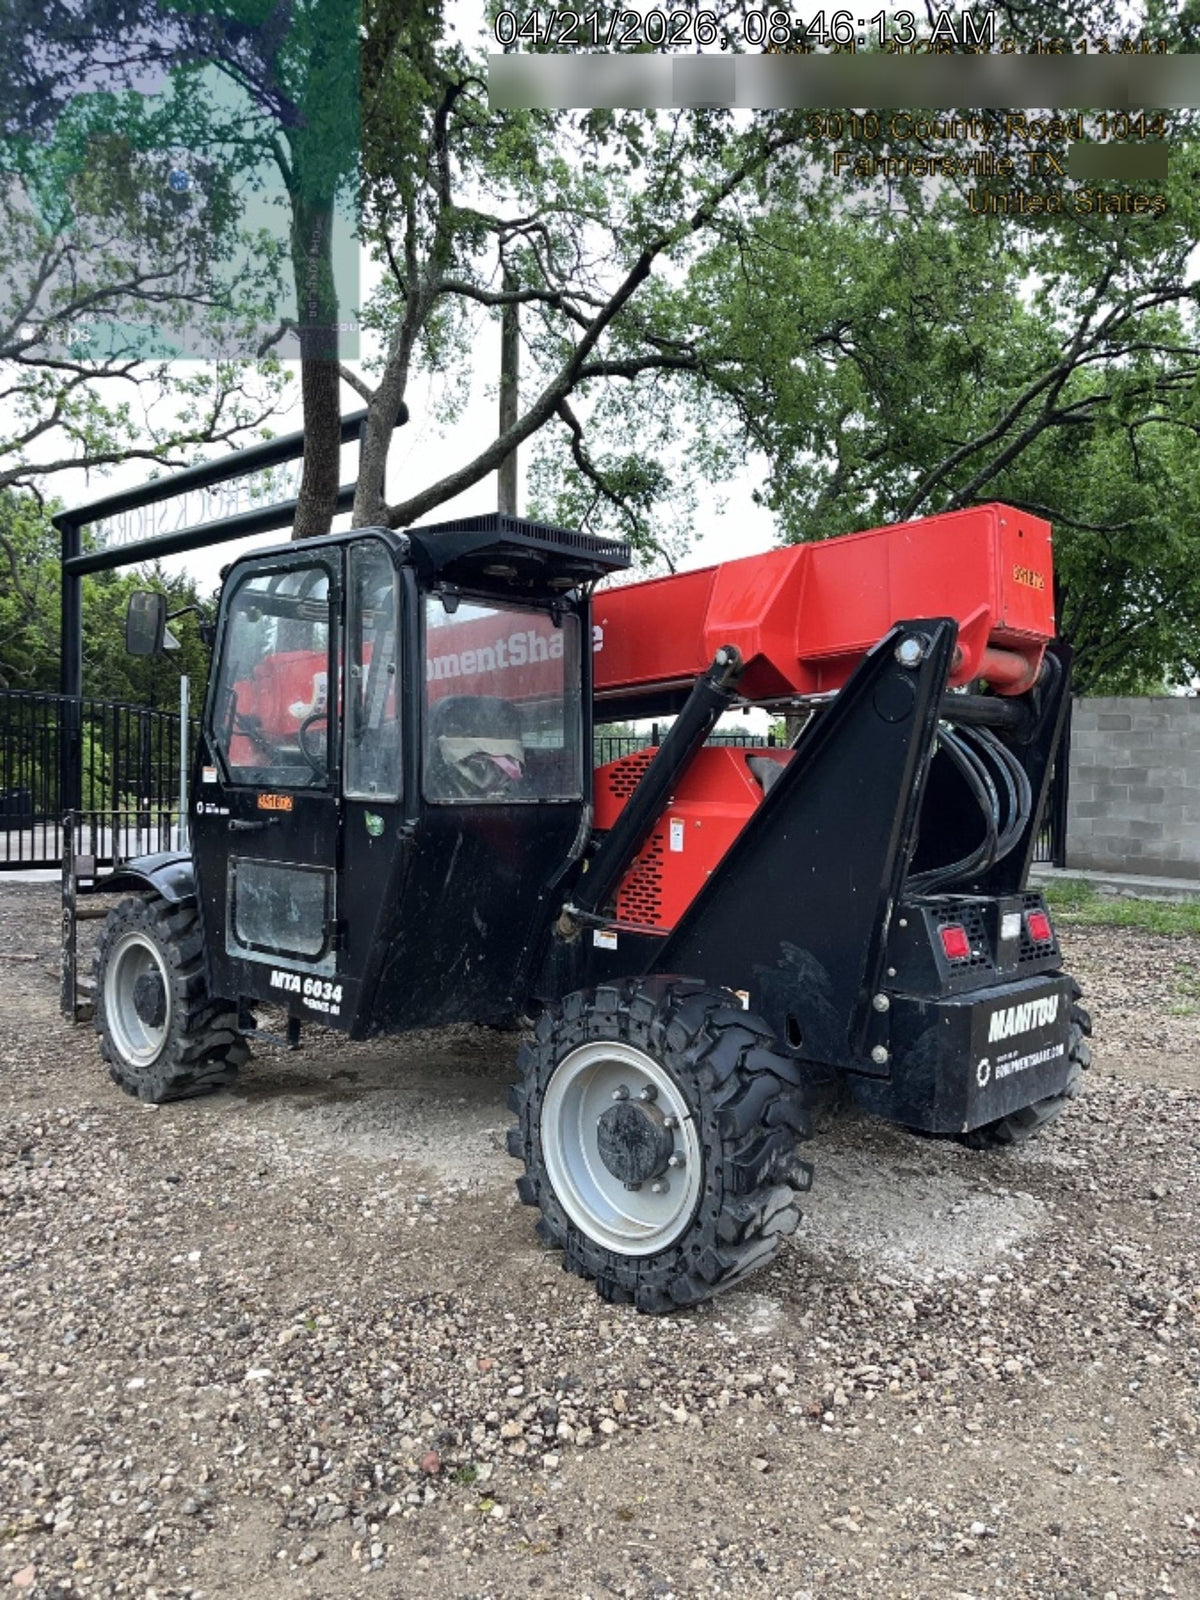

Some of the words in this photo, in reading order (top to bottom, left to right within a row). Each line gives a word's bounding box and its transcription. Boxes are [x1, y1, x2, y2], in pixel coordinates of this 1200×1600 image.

[270, 969, 301, 993] MTA
[303, 978, 343, 1003] 6034
[988, 993, 1059, 1043] MANITOU
